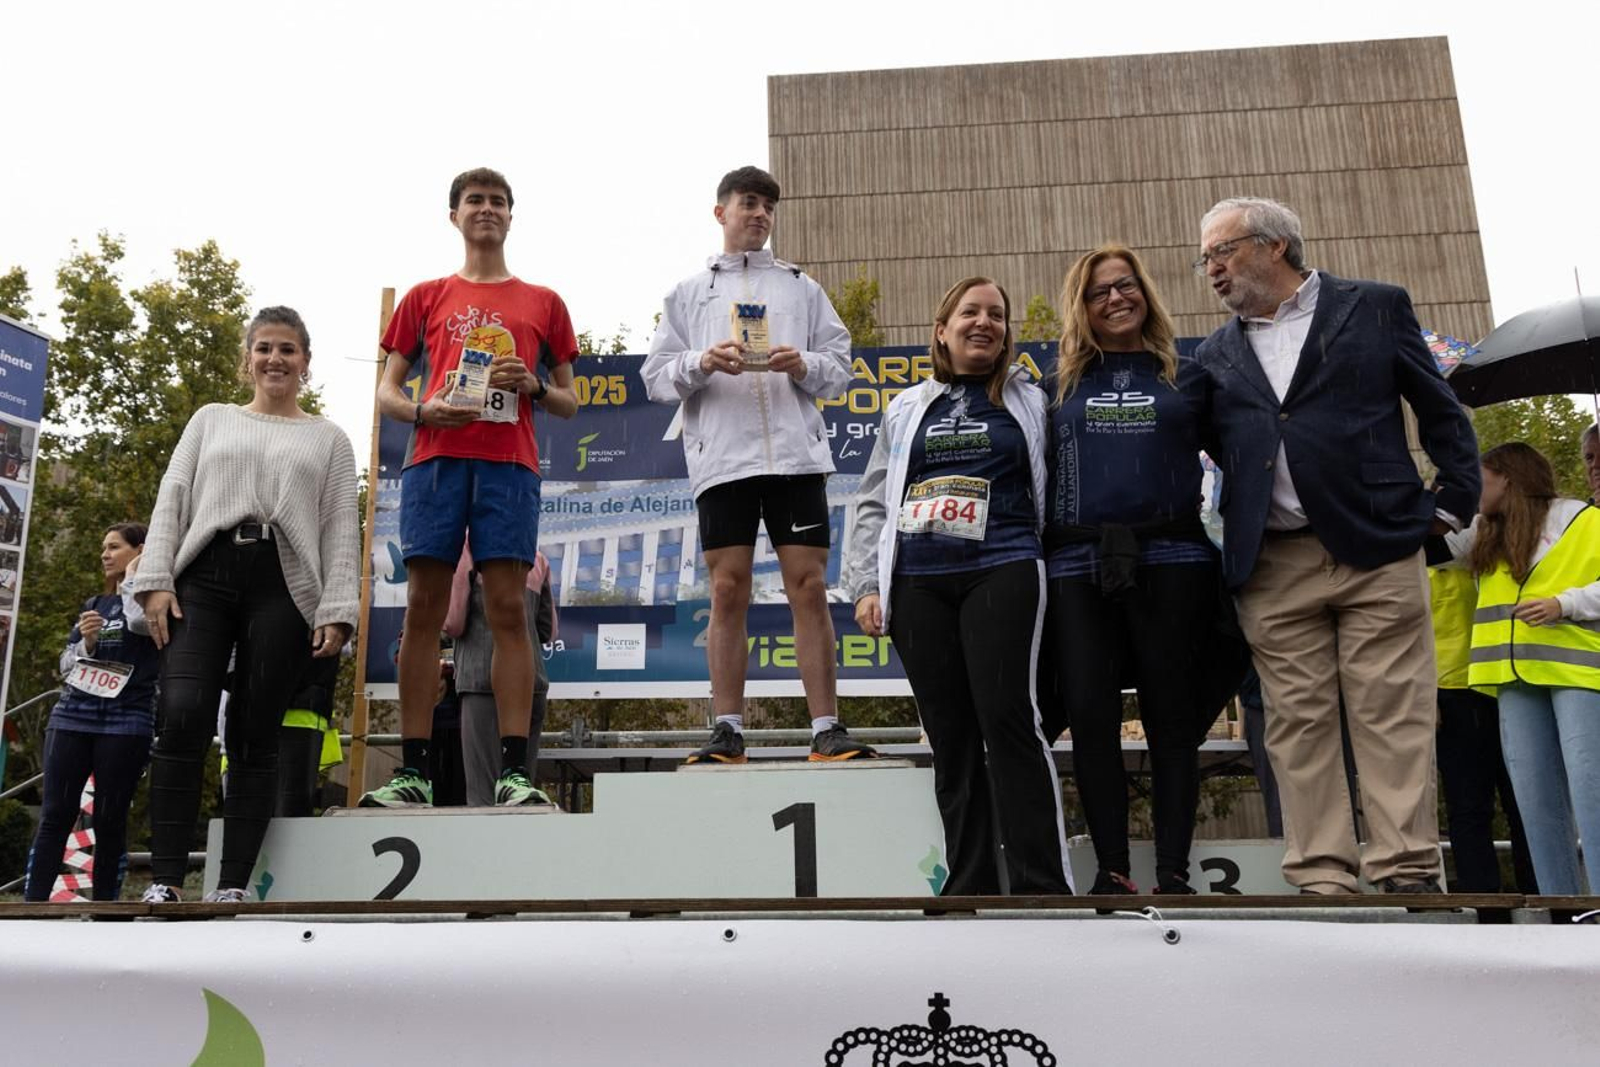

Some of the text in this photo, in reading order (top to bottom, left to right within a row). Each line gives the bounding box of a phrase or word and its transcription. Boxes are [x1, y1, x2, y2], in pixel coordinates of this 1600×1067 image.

[0, 349, 33, 371] inata
[0, 391, 27, 406] alores
[573, 375, 627, 406] 025
[1086, 392, 1155, 407] 25
[1086, 412, 1156, 421] POPULAR
[539, 496, 694, 516] talina de Alejan
[911, 498, 977, 524] 1184
[604, 635, 640, 646] Sierras
[79, 667, 120, 690] 1106
[772, 802, 817, 898] 1
[372, 836, 421, 900] 2
[1200, 857, 1243, 895] 3
